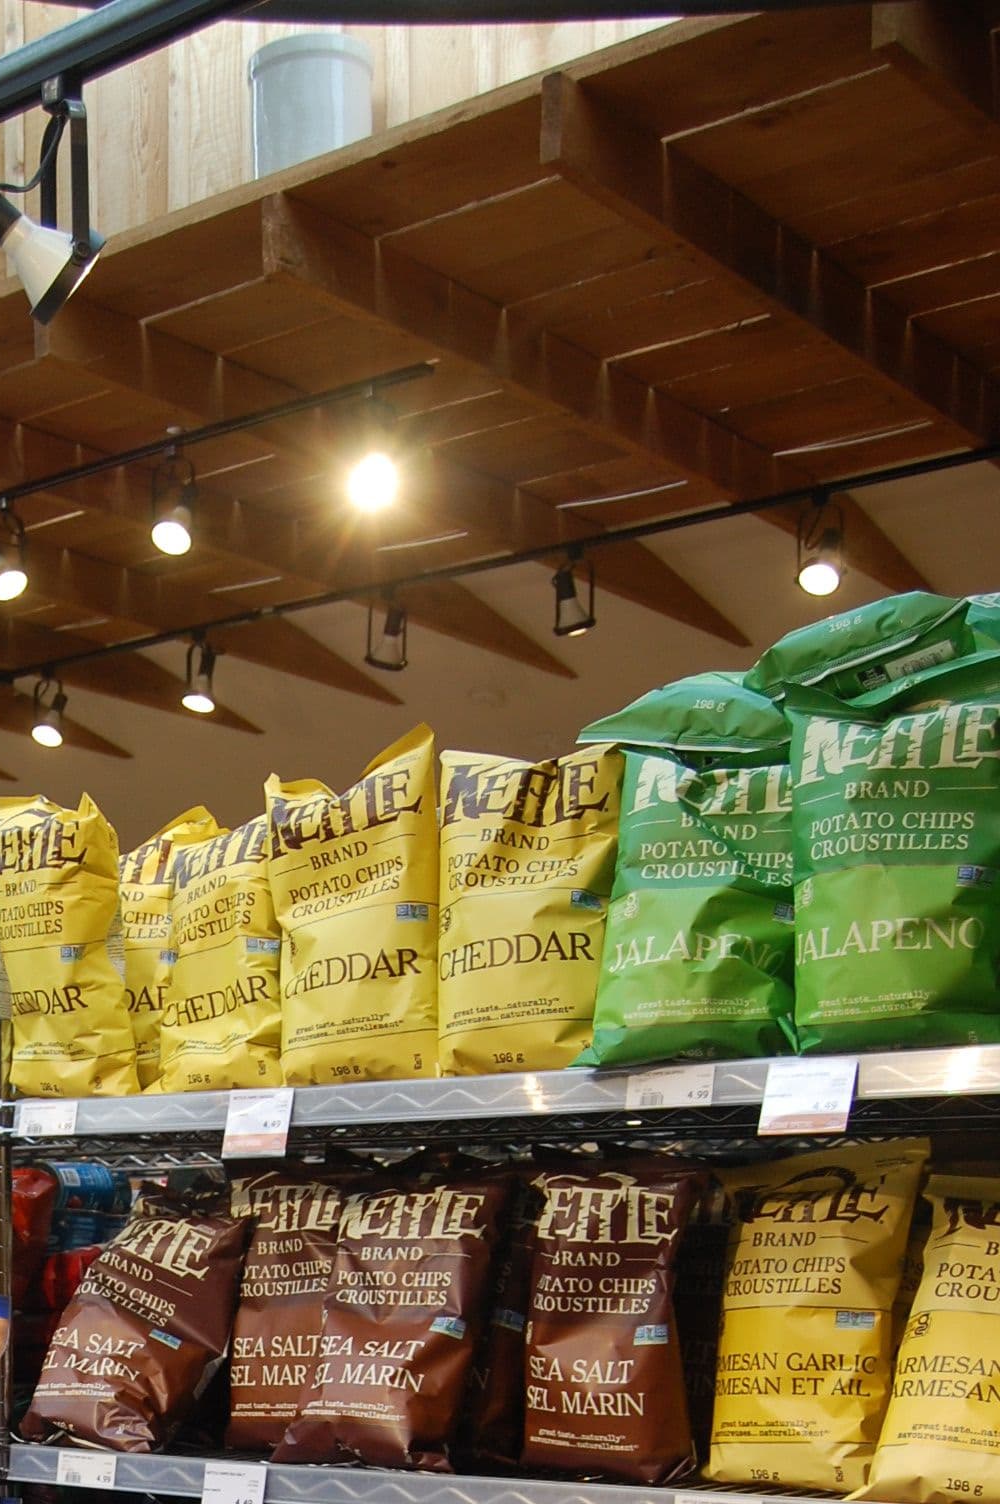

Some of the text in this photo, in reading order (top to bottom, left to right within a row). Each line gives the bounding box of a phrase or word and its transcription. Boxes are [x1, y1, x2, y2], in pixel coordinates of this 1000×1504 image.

[441, 761, 608, 828] KETTLE
[844, 780, 930, 800] BRAND
[269, 767, 422, 862] KETTLE
[810, 811, 974, 839] POTATO CHIPS
[480, 827, 550, 851] BRAND
[640, 841, 728, 860] POTATO
[810, 833, 969, 860] CROUSTILLES
[310, 841, 368, 871] BRAND
[448, 852, 519, 874] POTATO
[288, 856, 404, 904] POTATO CHIPS
[27, 901, 64, 915] CHIPS
[214, 891, 256, 917] CHIPS
[292, 876, 401, 919] CROUSTILLES
[440, 930, 594, 982] CHEDDAR
[284, 948, 422, 1000] CHEDDAR
[257, 1238, 303, 1256] BRAND
[752, 1230, 817, 1248] BRAND
[361, 1247, 424, 1262] BRAND
[793, 1256, 846, 1274] CHIPS
[293, 1260, 332, 1275] CHIPS
[336, 1270, 452, 1287] POTATO CHIPS
[335, 1289, 448, 1306] CROUSTILLES
[600, 1278, 657, 1295] CHIPS
[129, 1287, 177, 1317] CHIPS
[233, 1337, 265, 1358] SEA
[529, 1355, 634, 1385] SEA SALT
[785, 1351, 878, 1375] GARLIC
[791, 1376, 825, 1396] ET
[561, 1391, 644, 1417] MARIN
